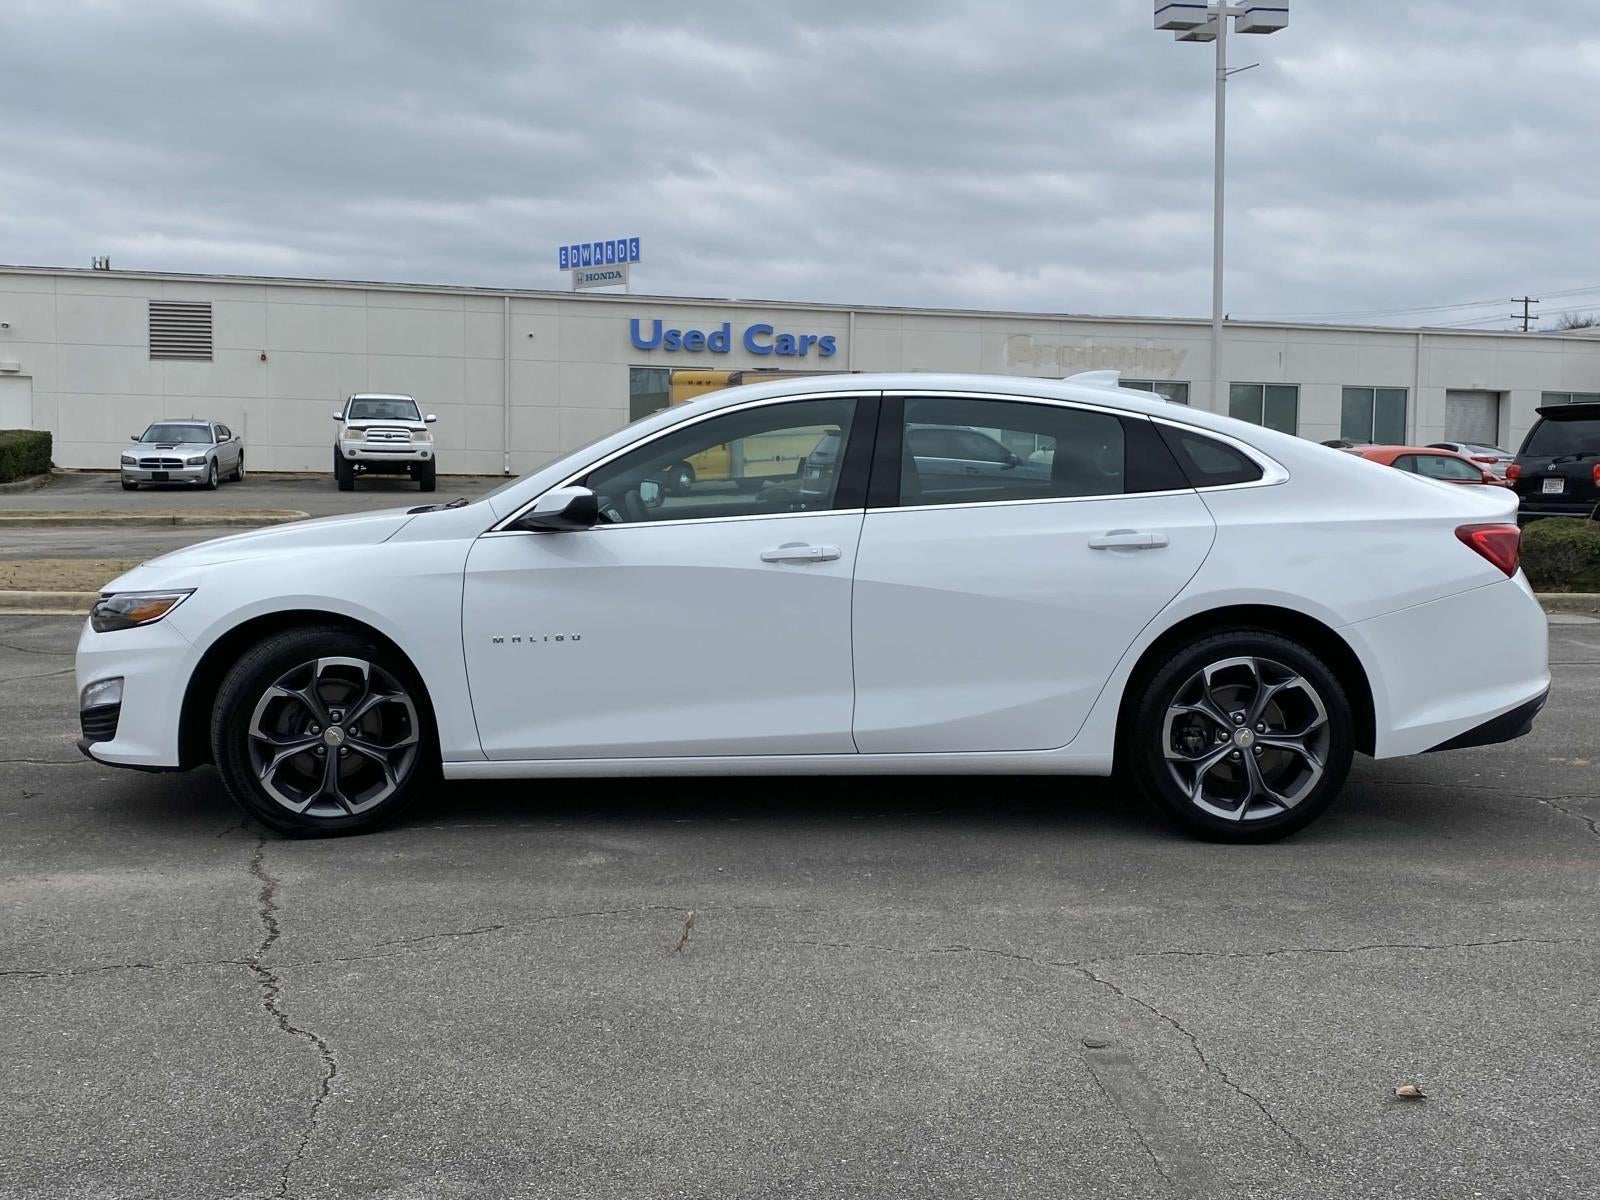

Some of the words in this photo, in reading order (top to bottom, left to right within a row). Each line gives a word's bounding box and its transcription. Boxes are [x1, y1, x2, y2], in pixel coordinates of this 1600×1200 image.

[561, 242, 637, 264] EDWARDS
[585, 270, 622, 281] HONDA
[630, 318, 731, 353] Used
[743, 323, 837, 357] Cars
[492, 633, 581, 644] MALIBU
